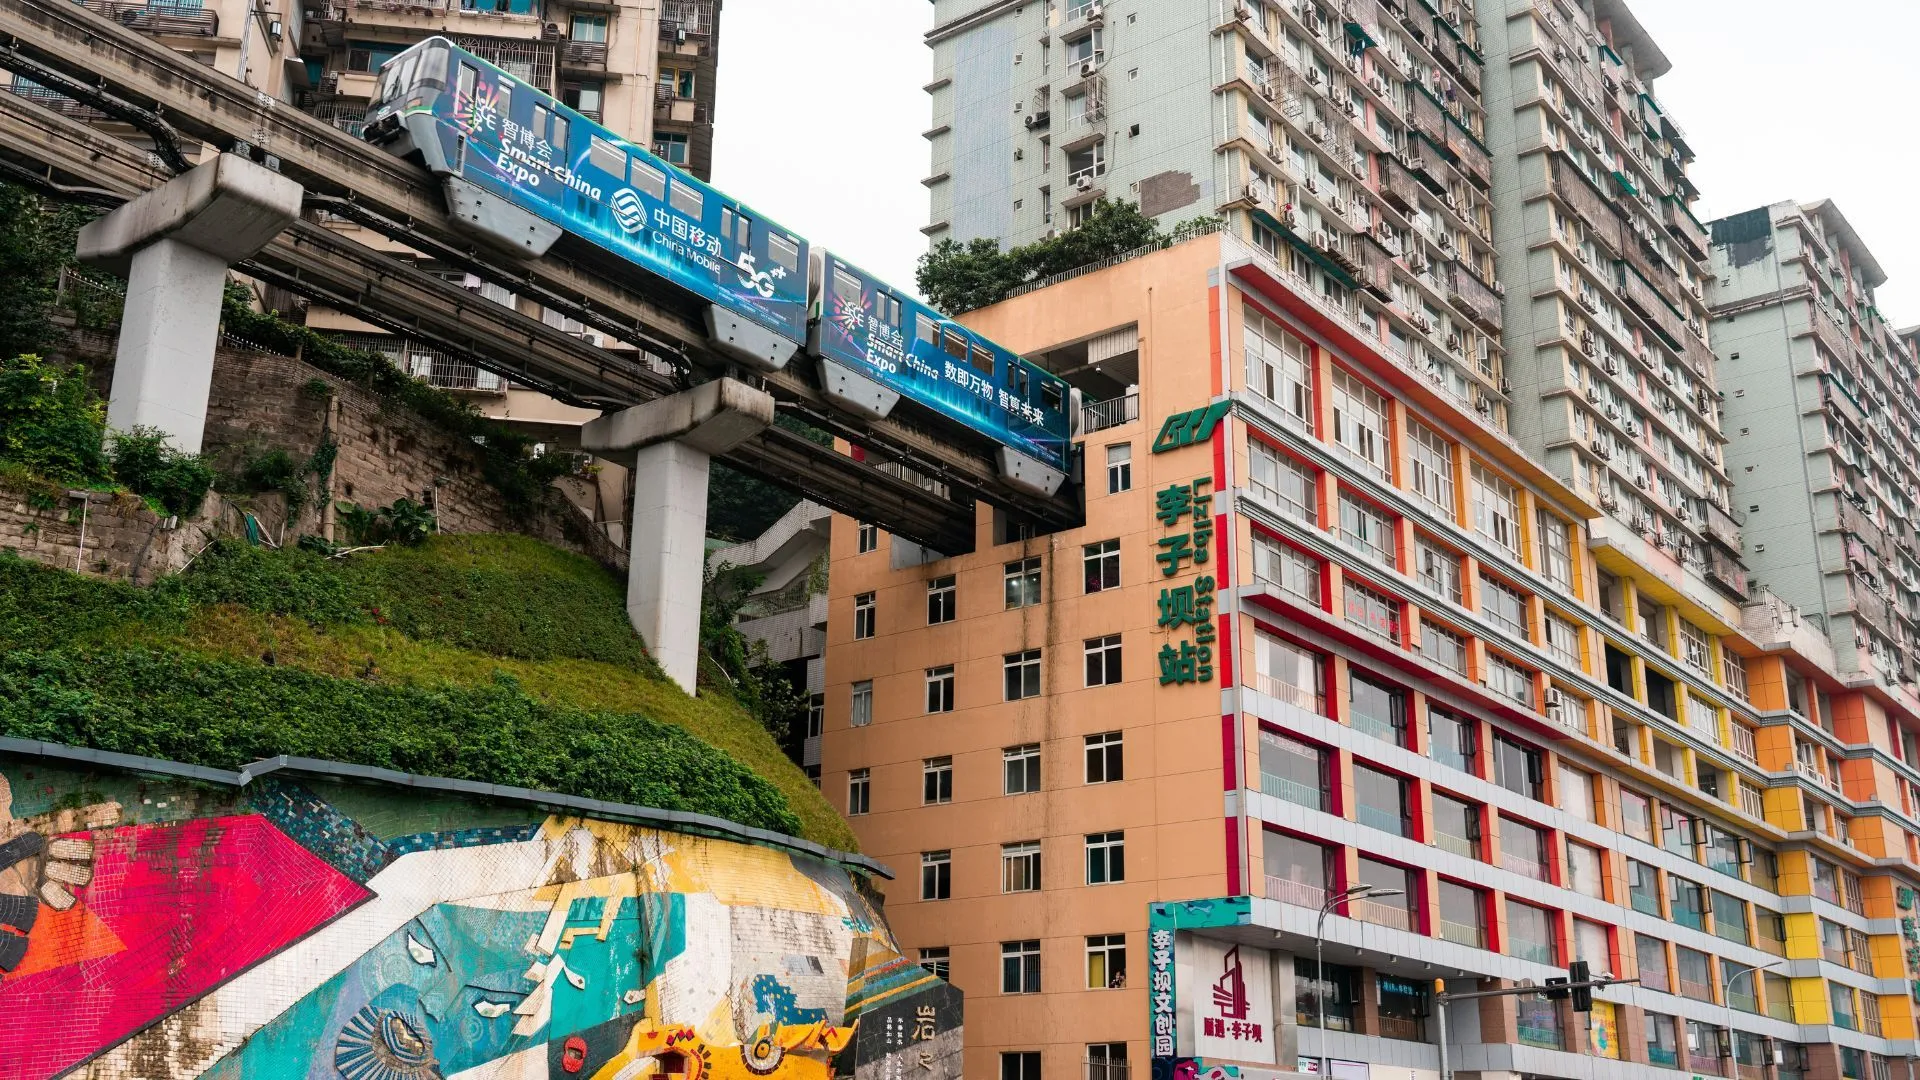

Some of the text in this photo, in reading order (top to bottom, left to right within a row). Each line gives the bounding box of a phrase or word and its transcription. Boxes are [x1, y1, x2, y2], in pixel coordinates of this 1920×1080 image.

[501, 117, 553, 160] 智博会
[496, 154, 541, 187] Expo
[499, 138, 552, 175] Smart
[554, 167, 603, 201] China
[652, 230, 721, 274] China Mobile
[653, 207, 722, 257] 中国移动
[867, 314, 904, 347] 智博会
[866, 332, 905, 362] Smart
[905, 352, 939, 381] China
[866, 349, 897, 374] Expo
[944, 360, 994, 401] 数即万物
[998, 387, 1045, 427] 智算未来
[1155, 483, 1197, 686] 李子坝站
[1192, 476, 1216, 683] Liziba Station
[1152, 929, 1174, 1057] 李子坝文创园
